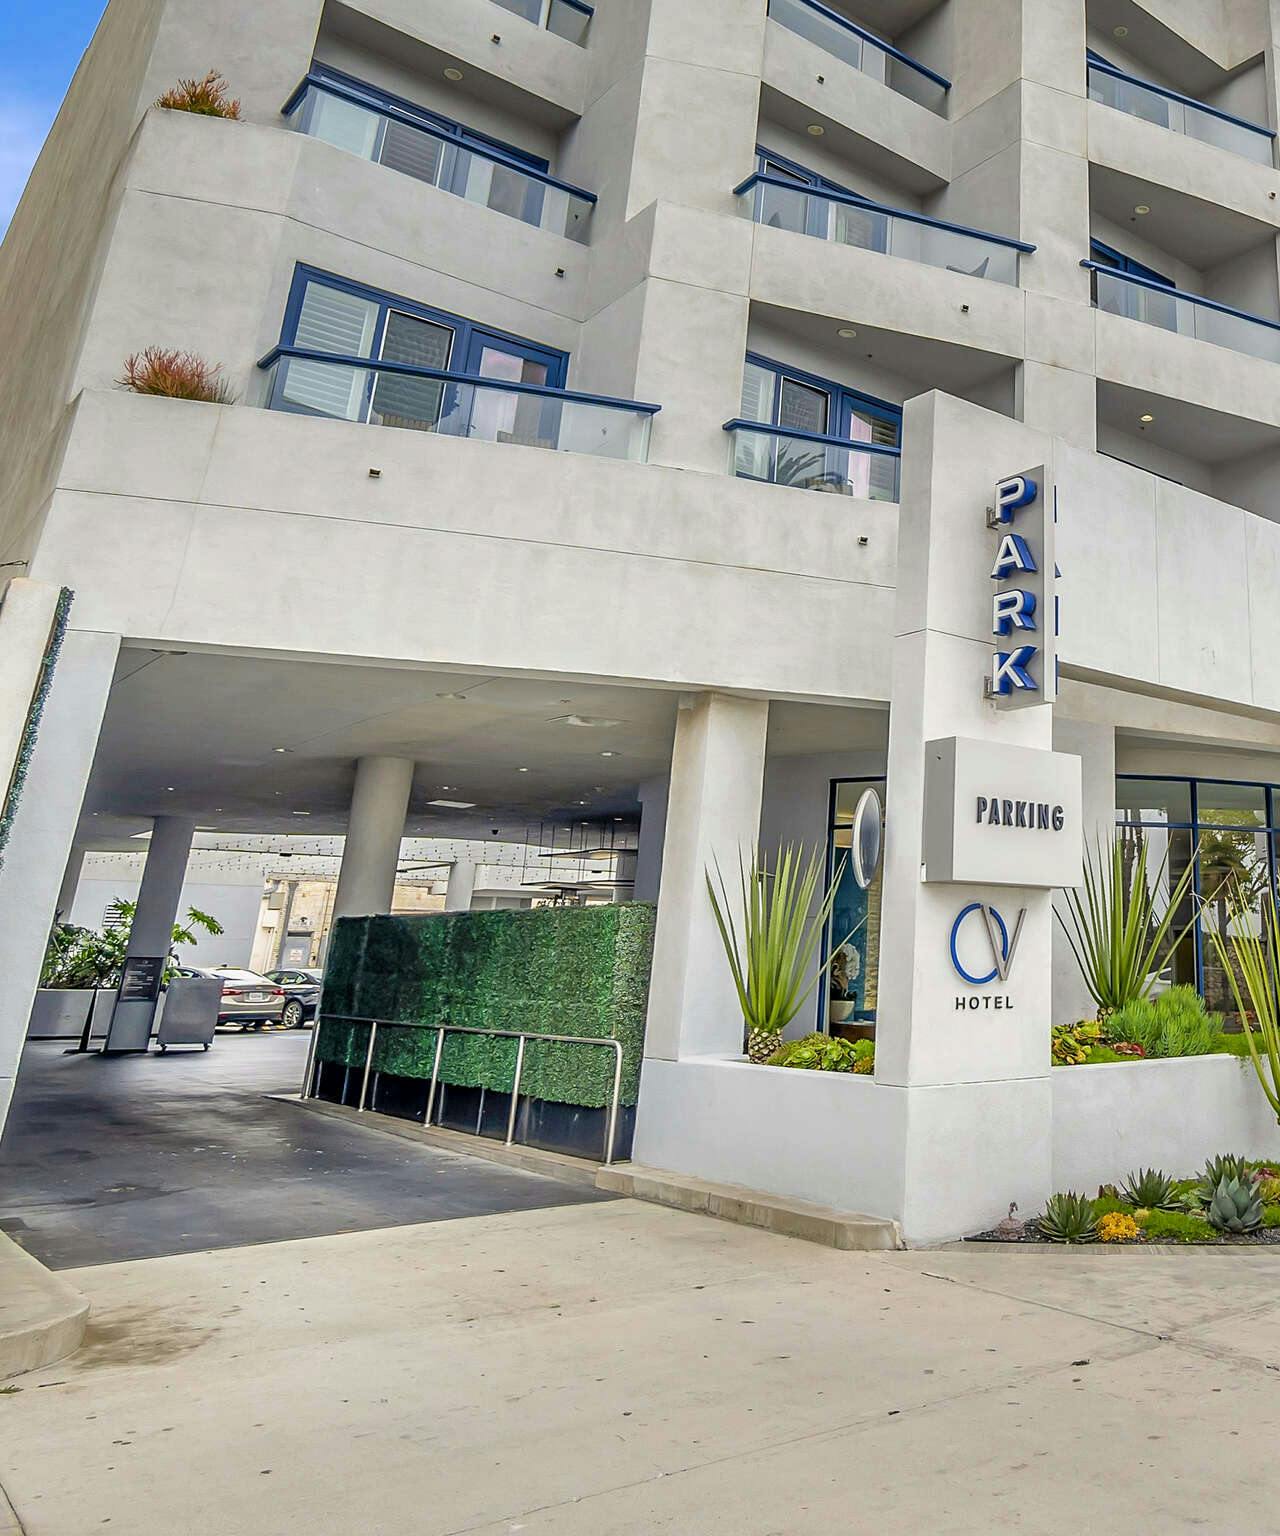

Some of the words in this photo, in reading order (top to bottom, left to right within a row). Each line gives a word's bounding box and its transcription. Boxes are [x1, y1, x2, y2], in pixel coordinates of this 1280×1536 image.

[990, 475, 1038, 696] PARK
[975, 795, 1066, 832] PARKING
[950, 902, 1028, 985] OV
[954, 995, 1015, 1011] HOTEL
